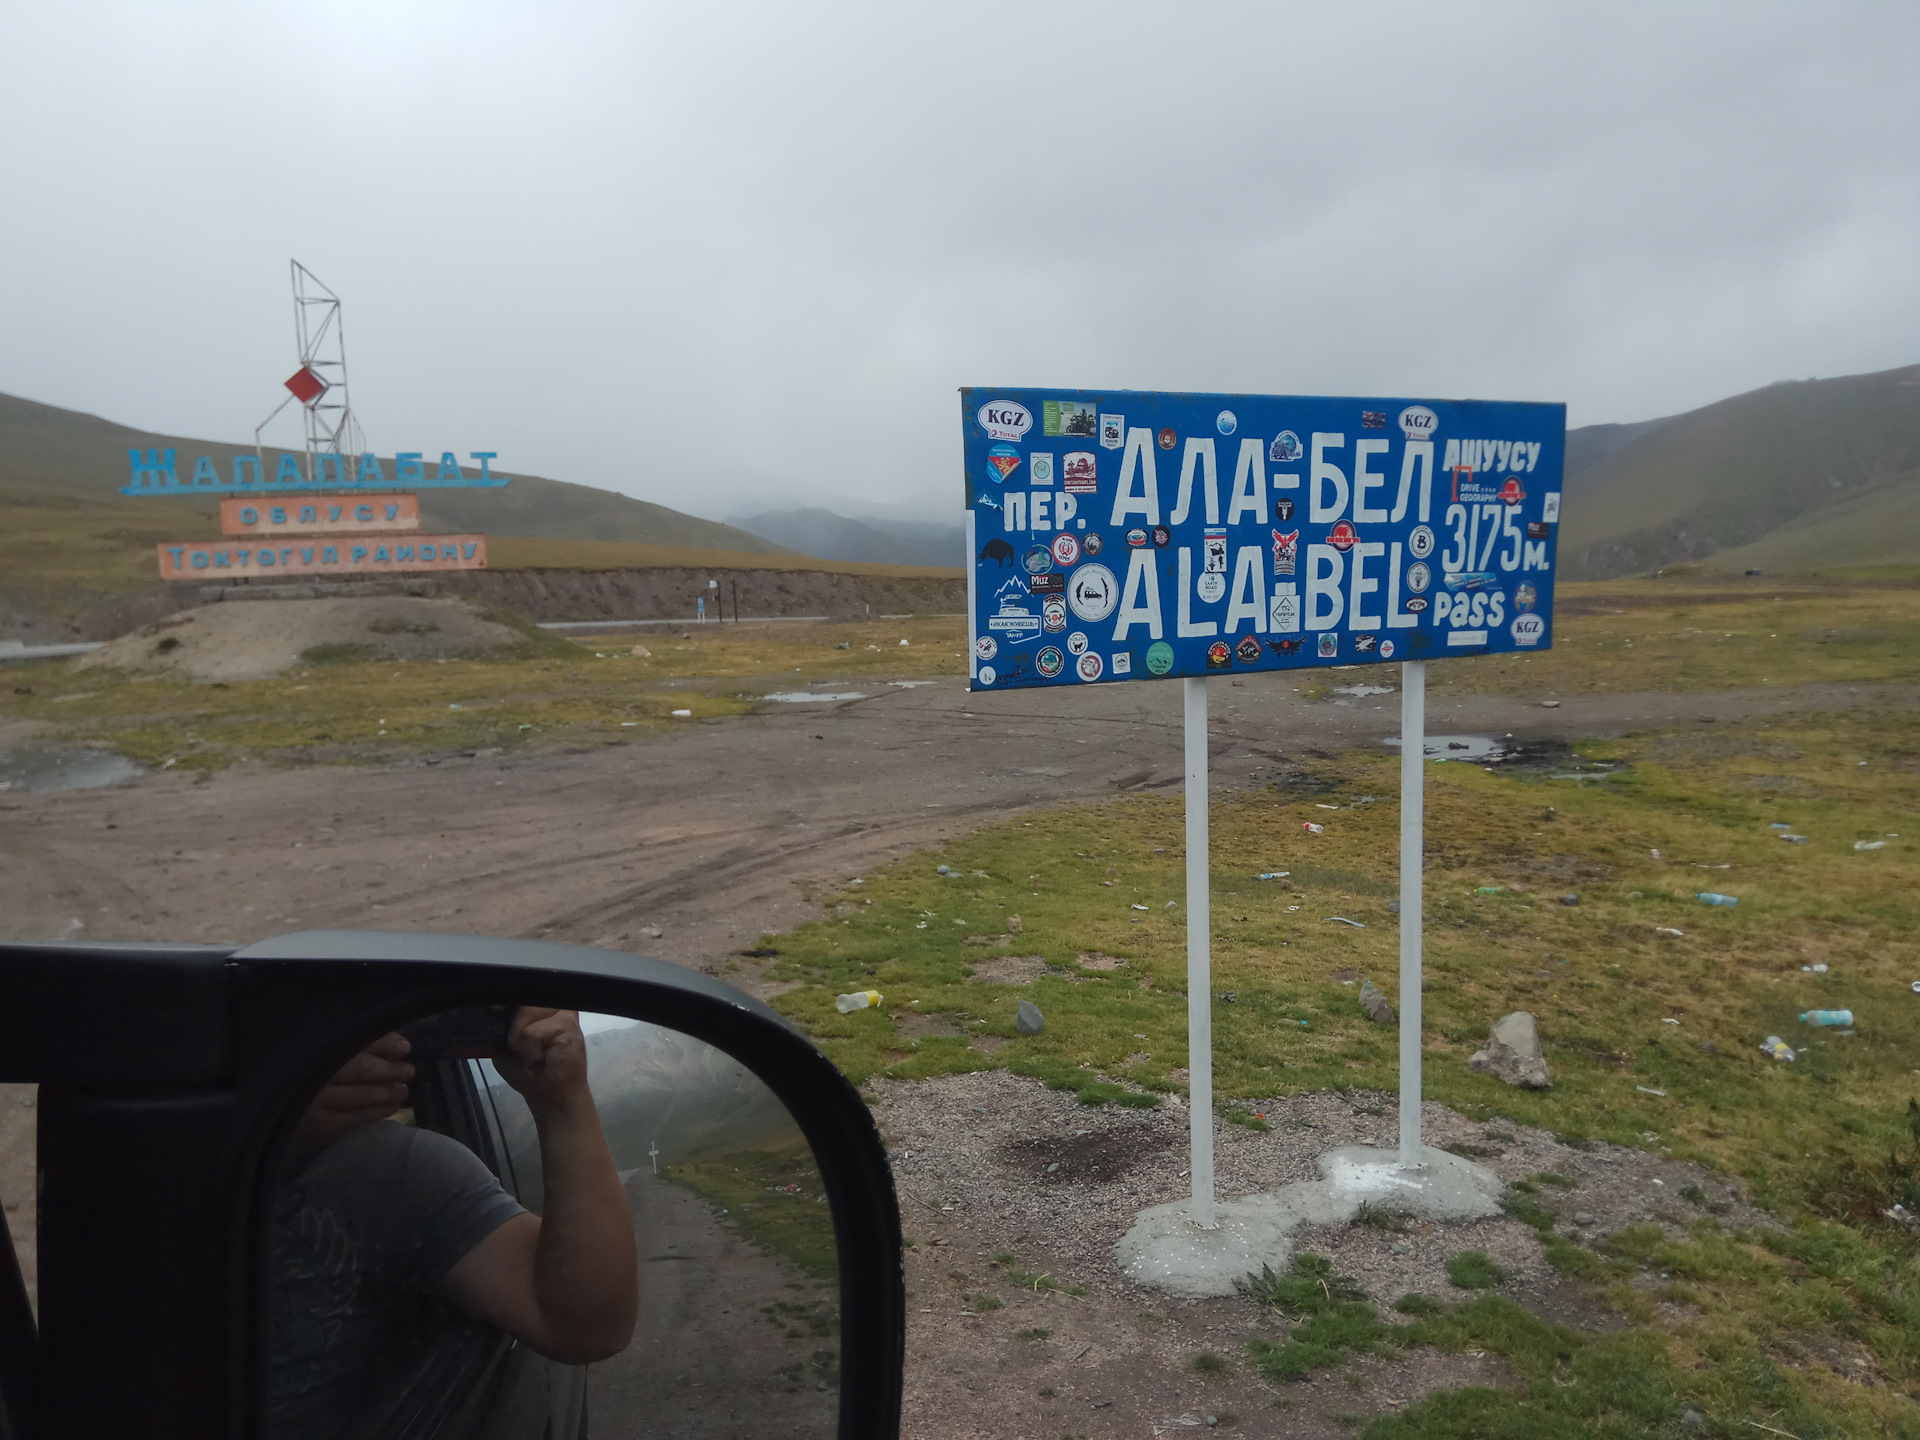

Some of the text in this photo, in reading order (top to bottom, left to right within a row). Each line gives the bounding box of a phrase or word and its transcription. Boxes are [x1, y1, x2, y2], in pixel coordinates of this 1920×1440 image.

[987, 408, 1025, 427] KGZ
[1404, 414, 1432, 428] KGZ
[1004, 426, 1435, 533] ПЕР. АЛА-БЕЛ
[1460, 483, 1480, 493] DRIVE
[1459, 493, 1497, 503] GEOGRAPHY
[239, 502, 400, 526] ОБЛУСУ
[1112, 541, 1419, 641] ALA-BEL
[1516, 621, 1539, 633] KGZ
